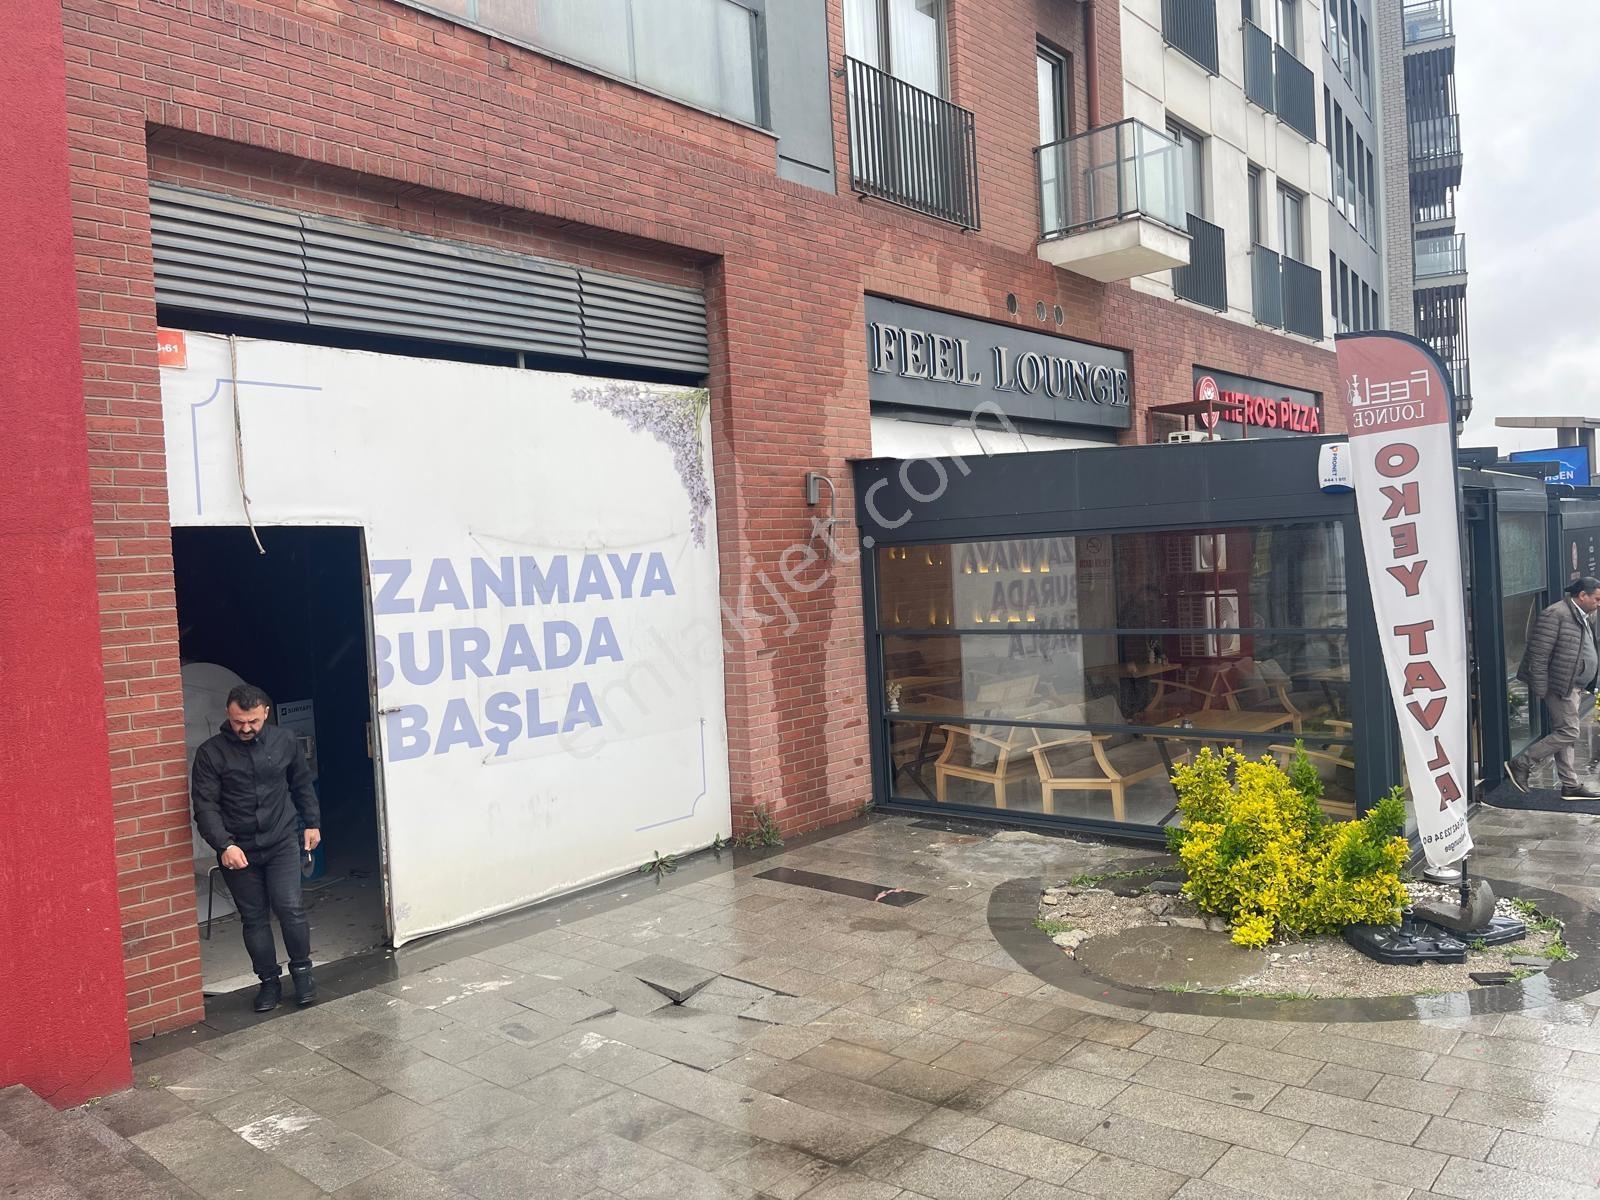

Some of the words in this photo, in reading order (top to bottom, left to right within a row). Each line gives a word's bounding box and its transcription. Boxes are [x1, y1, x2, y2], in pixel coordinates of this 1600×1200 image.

[870, 322, 982, 387] FEEL
[993, 346, 1130, 407] LOUNGE
[370, 552, 676, 615] ZANMAYA
[386, 682, 603, 763] BAŞLA
